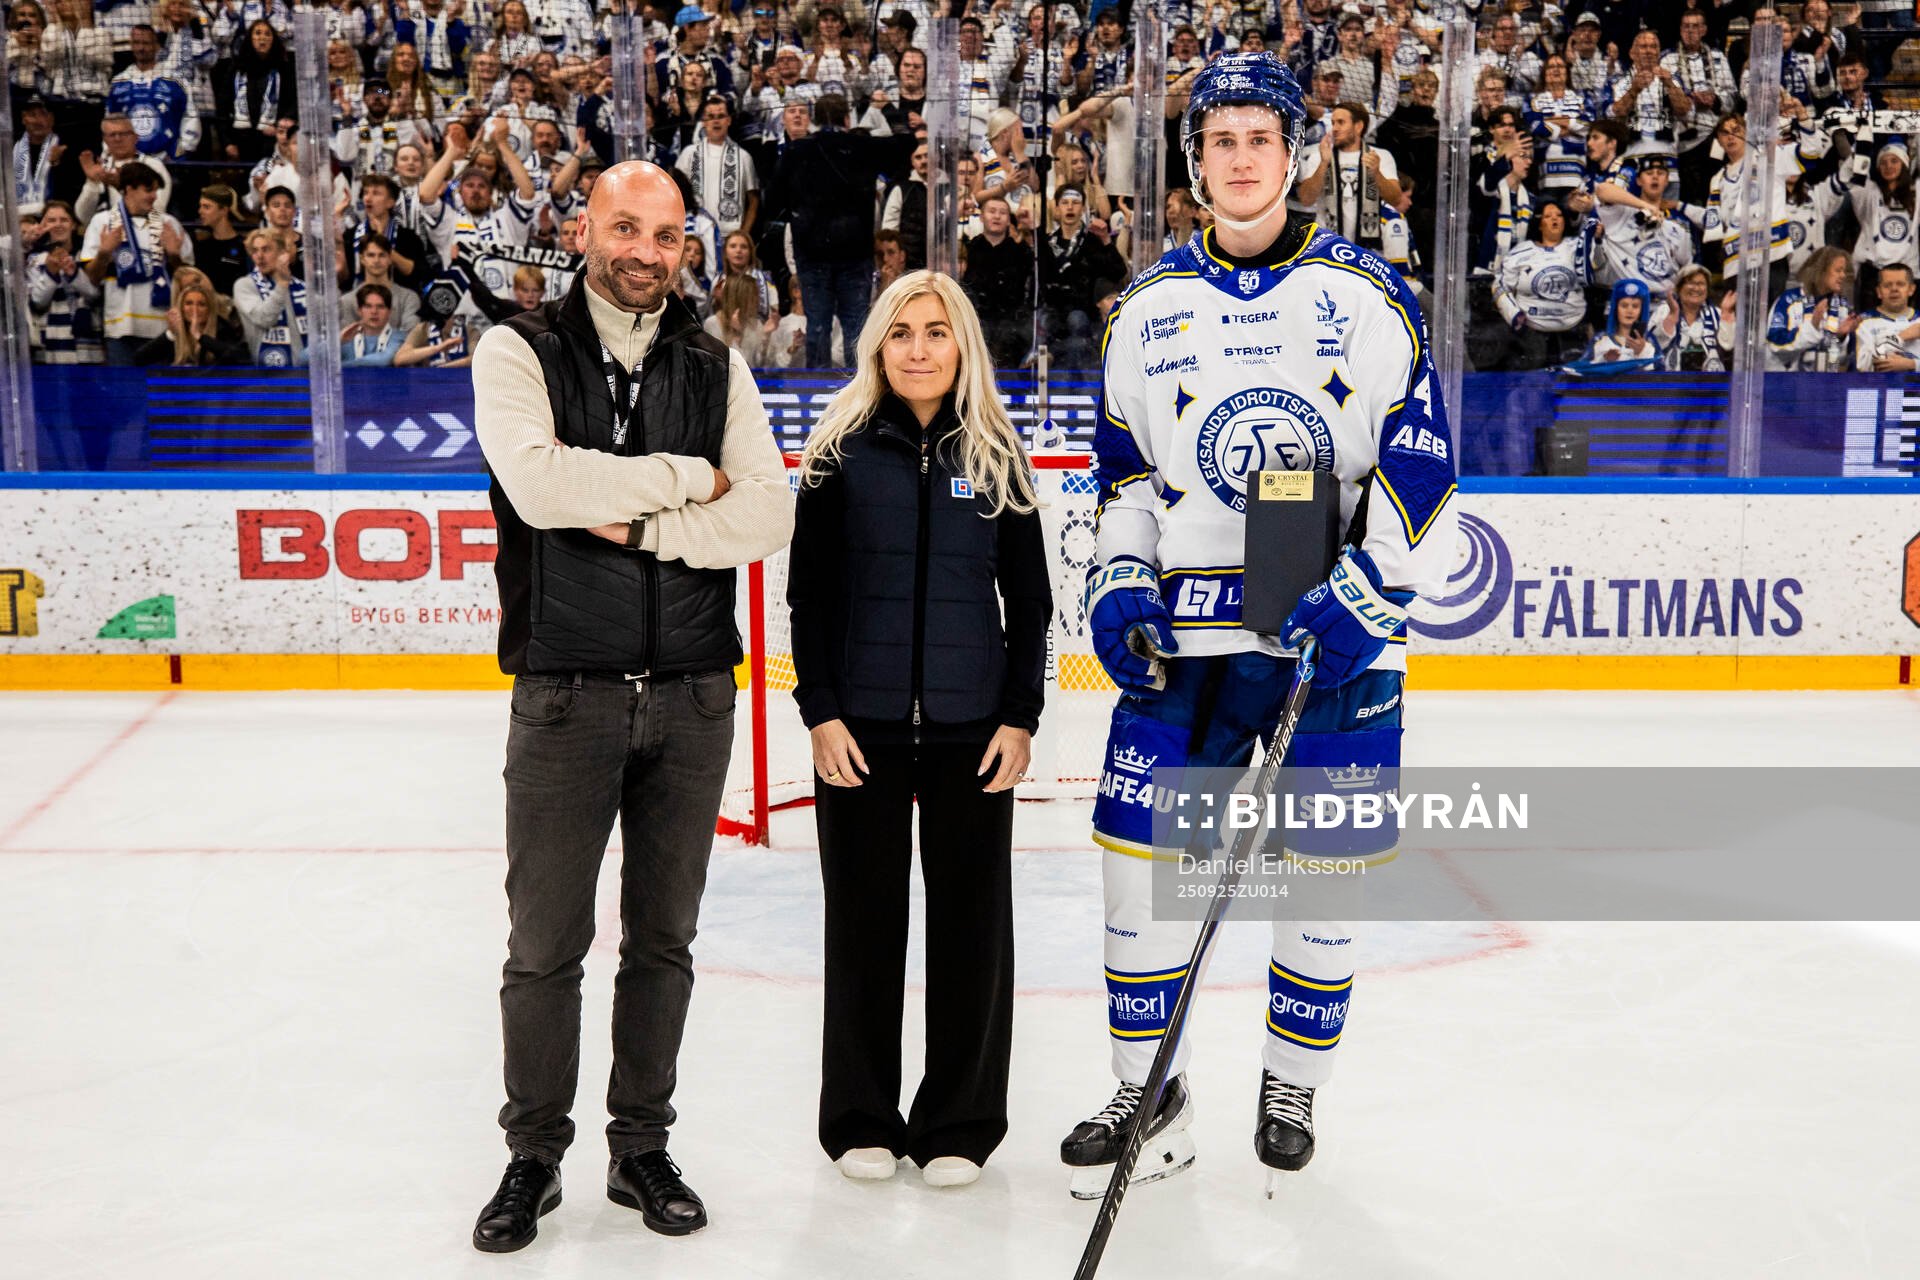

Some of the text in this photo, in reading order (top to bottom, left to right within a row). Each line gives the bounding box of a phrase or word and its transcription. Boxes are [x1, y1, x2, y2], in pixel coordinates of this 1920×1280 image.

[1239, 275, 1259, 290] 50
[1359, 260, 1399, 296] Ohlson
[1153, 325, 1180, 340] Siljan
[1200, 406, 1231, 489] LEKSANDS
[1389, 425, 1447, 459] AEB
[1512, 565, 1804, 639] FÄLTMANS
[351, 607, 406, 624] BYGG
[1118, 1012, 1159, 1021] ELECTRO
